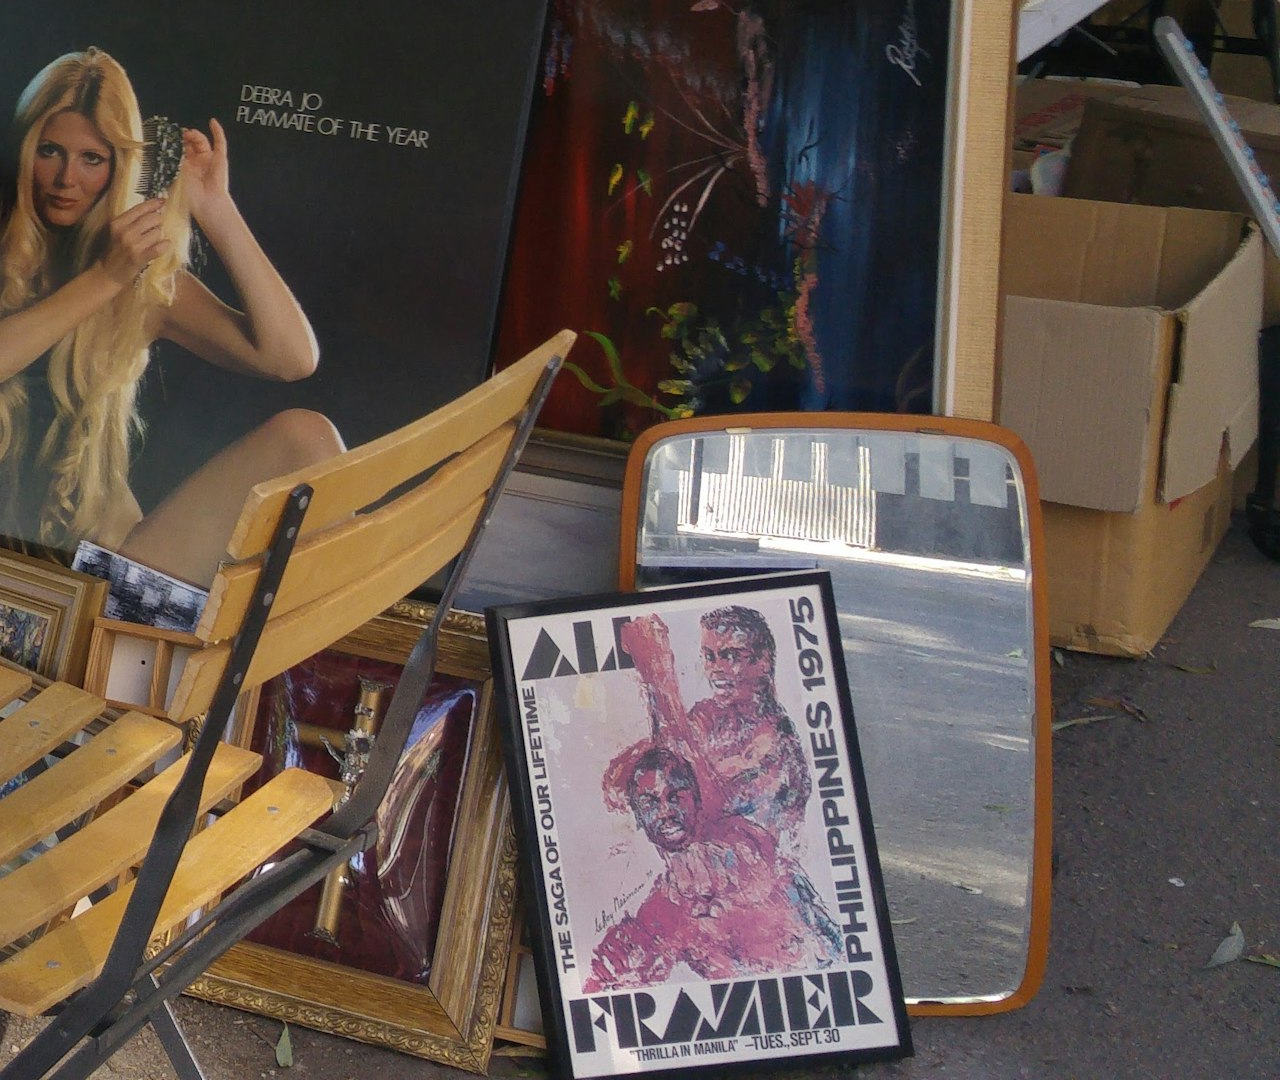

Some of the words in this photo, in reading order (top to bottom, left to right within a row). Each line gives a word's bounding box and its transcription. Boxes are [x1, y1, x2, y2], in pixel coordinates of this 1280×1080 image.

[240, 84, 293, 108] DEBRA
[297, 92, 323, 112] JO
[236, 106, 316, 133] PLAYMATE
[317, 117, 344, 136] OF
[349, 120, 382, 142] THE
[386, 125, 430, 149] YEAR
[521, 615, 637, 682] ALI
[788, 595, 827, 693] 1975
[521, 686, 548, 781] LIFETIME
[534, 784, 555, 831] OUR
[805, 700, 873, 965] PHILIPPINES
[542, 835, 560, 865] OF
[547, 869, 570, 926] SAGA
[558, 930, 576, 974] THE
[568, 969, 884, 1054] FRAZIER
[680, 1046, 692, 1057] IN
[790, 1031, 823, 1047] SEPT.
[824, 1028, 841, 1044] 30
